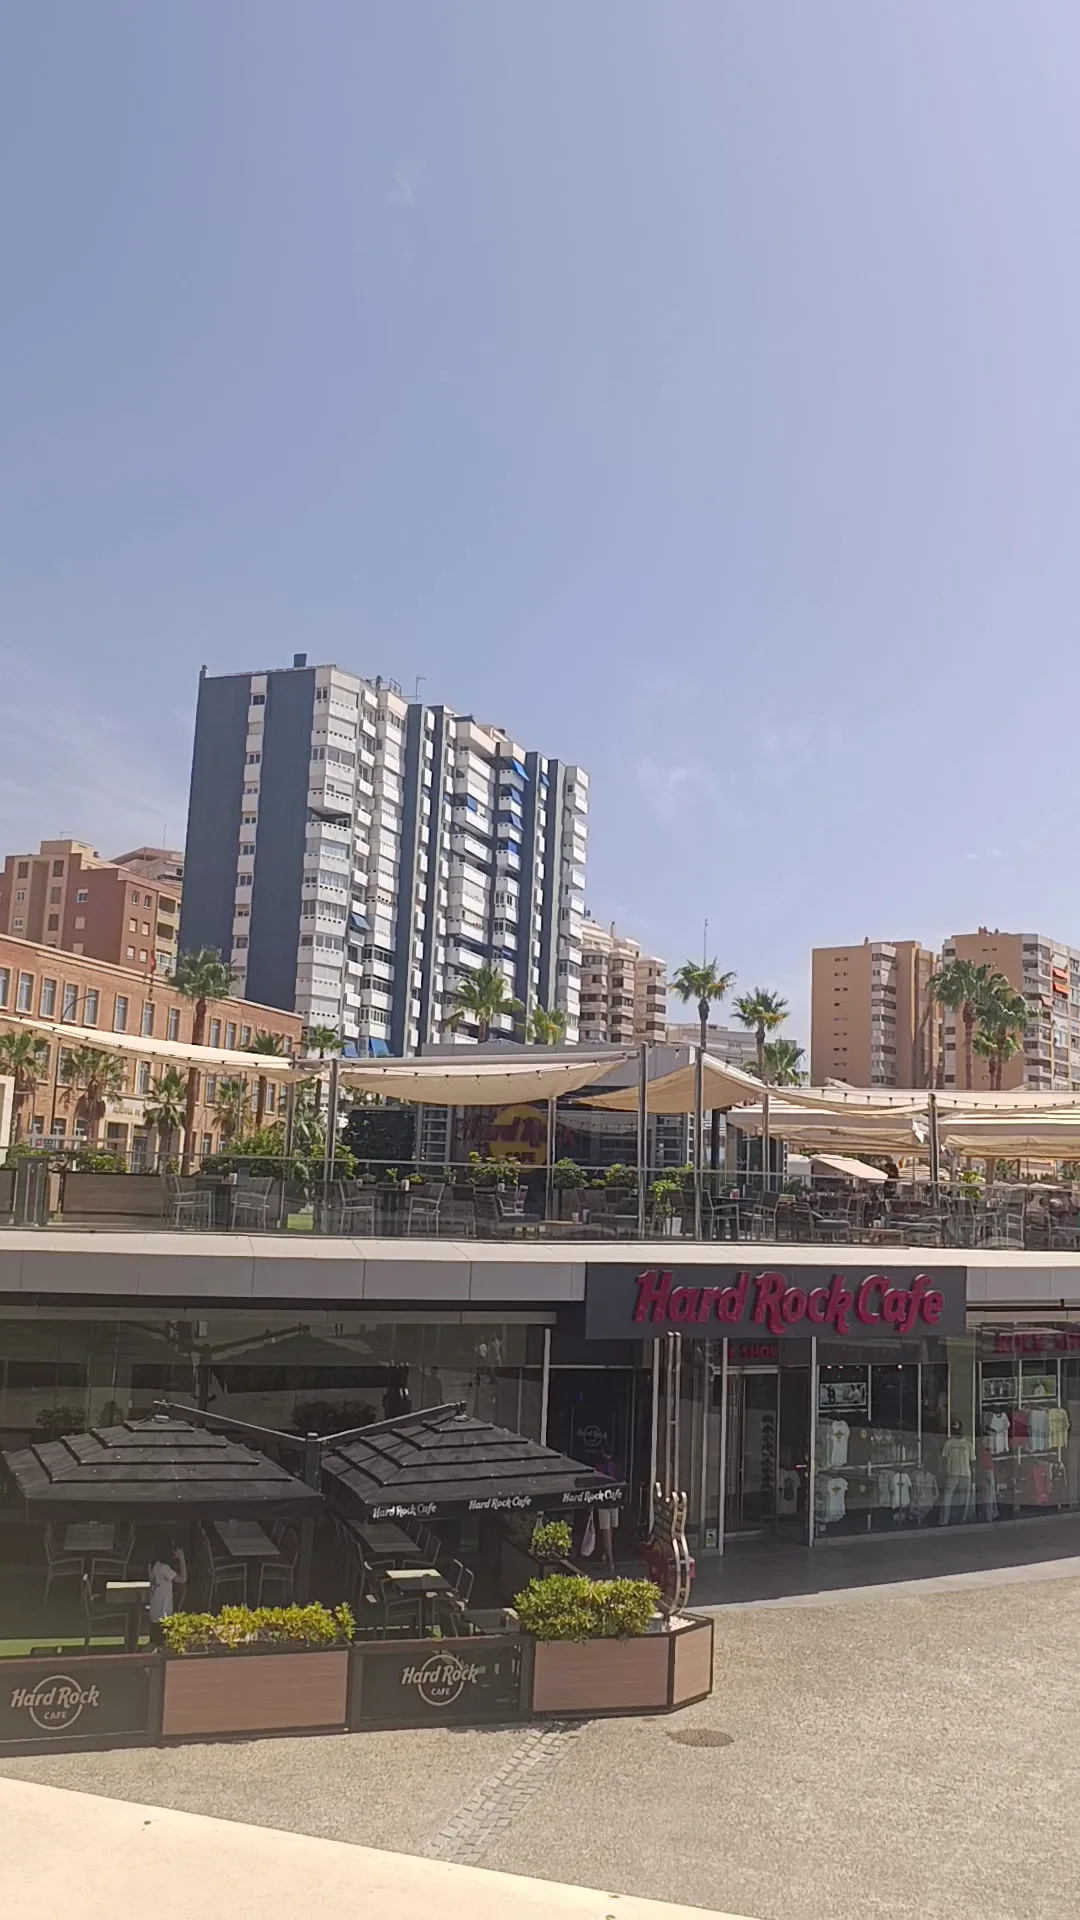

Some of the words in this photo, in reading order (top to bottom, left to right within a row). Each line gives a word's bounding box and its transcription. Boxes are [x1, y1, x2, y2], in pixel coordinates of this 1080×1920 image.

[522, 1116, 574, 1149] Rok
[632, 1270, 749, 1324] Hard
[752, 1271, 853, 1335] Rock
[856, 1273, 944, 1334] Cafe
[741, 1344, 777, 1359] SHOP
[468, 1498, 491, 1510] Hard
[491, 1497, 511, 1510] Rock
[511, 1495, 532, 1508] Cafe
[562, 1491, 584, 1503] Hard
[583, 1490, 604, 1503] Rock
[604, 1488, 623, 1501] Cafe
[372, 1505, 395, 1519] Hard
[395, 1504, 417, 1518] Rock
[417, 1502, 437, 1516] Cafe
[401, 1664, 442, 1685] Hard
[441, 1663, 478, 1686] Rock
[10, 1686, 57, 1708] Hard
[56, 1684, 100, 1709] Rock
[430, 1687, 450, 1696] CAFE
[43, 1711, 68, 1720] CAFE
